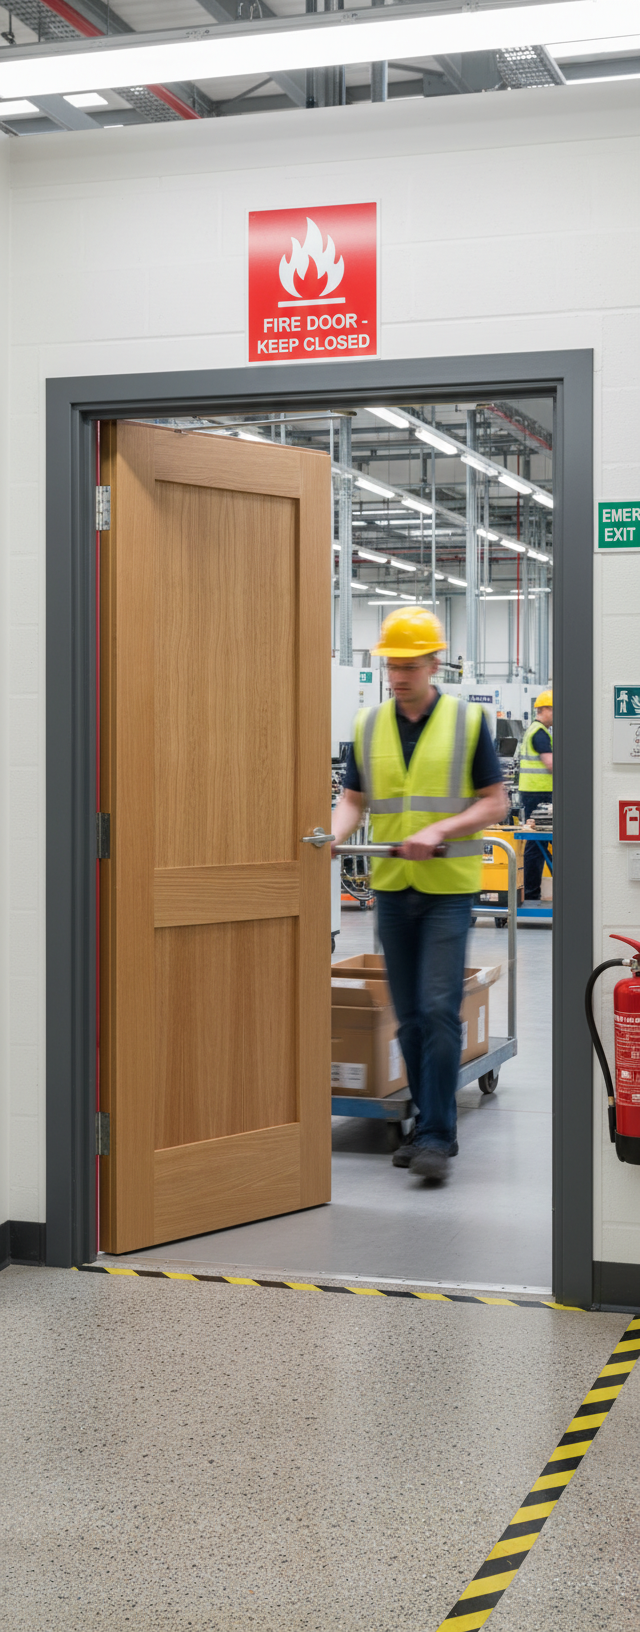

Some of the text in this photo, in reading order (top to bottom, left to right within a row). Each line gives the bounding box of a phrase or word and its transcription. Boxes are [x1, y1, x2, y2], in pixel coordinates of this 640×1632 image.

[263, 317, 301, 333] FIRE
[307, 313, 357, 331] DOOR
[257, 334, 370, 354] KEEP CLOSED
[602, 508, 640, 522] EMER
[604, 527, 636, 541] EXIT
